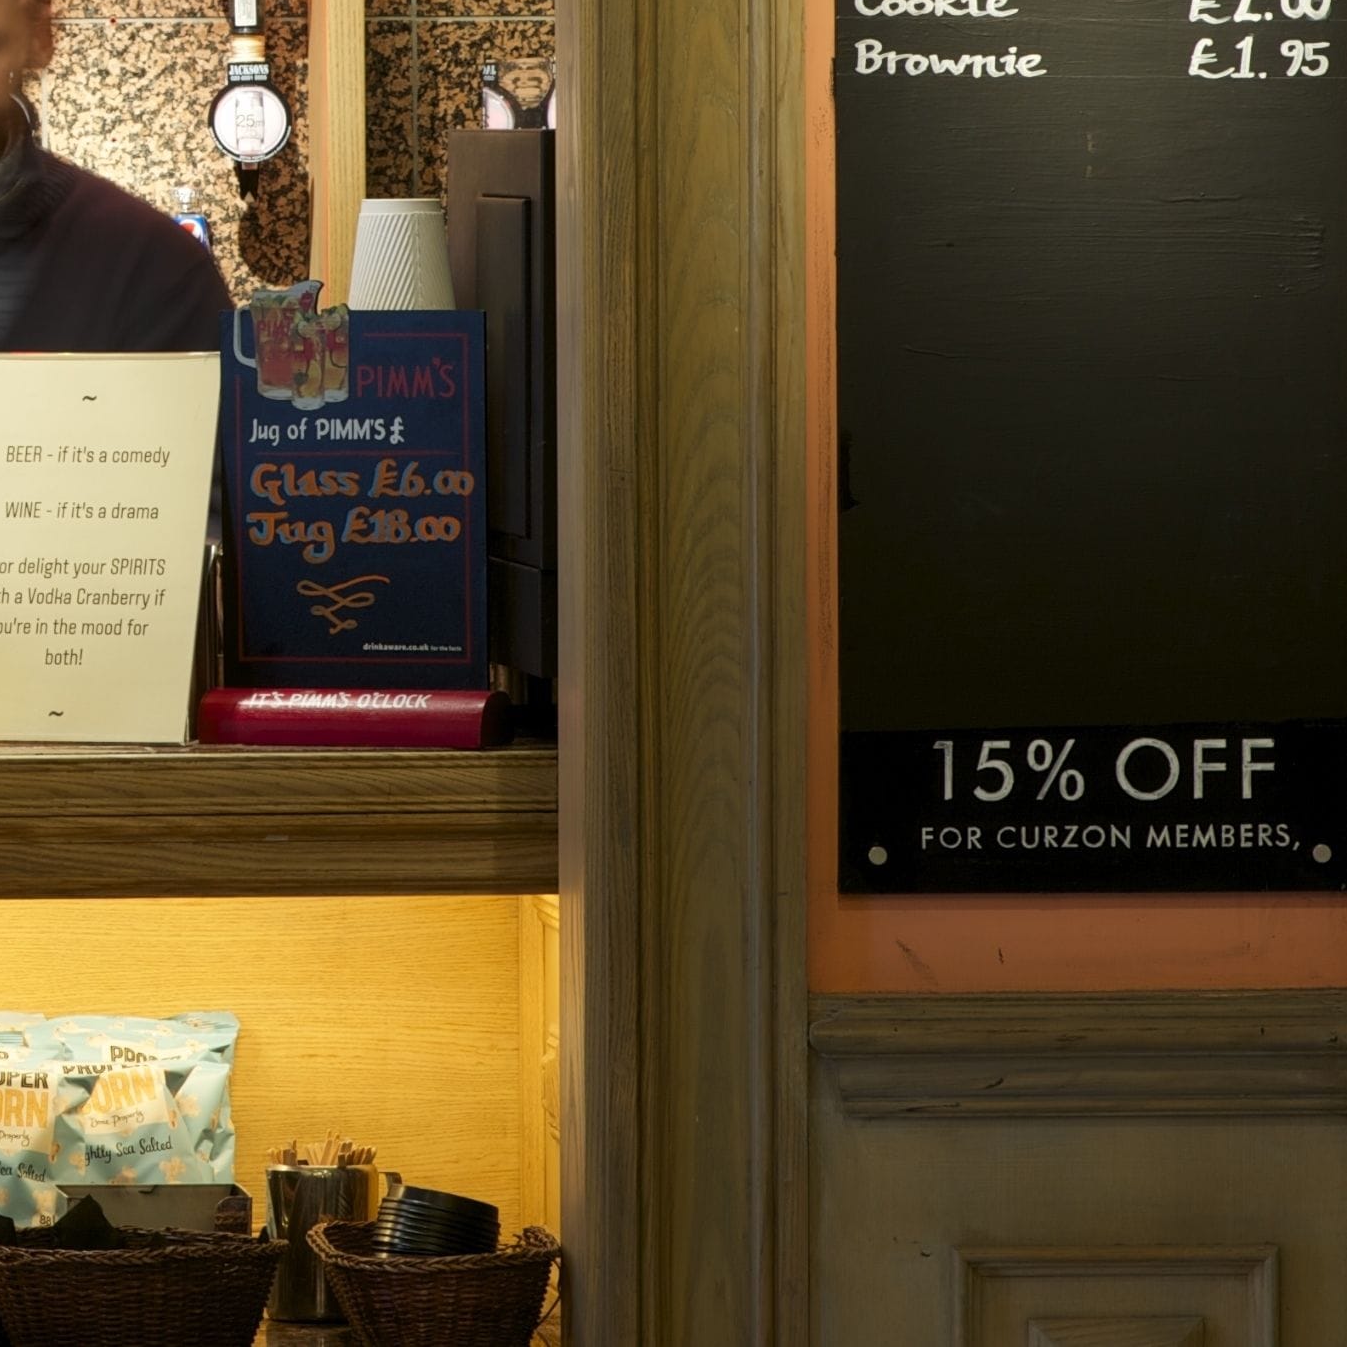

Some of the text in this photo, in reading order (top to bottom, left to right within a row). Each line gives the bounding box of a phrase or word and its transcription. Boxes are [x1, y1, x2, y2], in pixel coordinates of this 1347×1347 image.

[855, 36, 1330, 79] Brownie £1.95
[357, 358, 456, 398] PIMM'S
[249, 419, 386, 445] Jug of PIMM'S
[6, 445, 170, 467] BEER if it's a comedy
[250, 459, 474, 506] Glass £6.00
[246, 507, 462, 564] Jug £18.00
[18, 557, 69, 578] delight
[73, 560, 106, 578] your
[110, 557, 165, 575] SPIRITS
[14, 591, 23, 604] a
[28, 587, 71, 604] Vodka
[77, 587, 150, 608] Cranberry
[155, 587, 165, 605] if
[45, 647, 83, 666] both!
[363, 643, 429, 651] drinkaware.co.uk
[250, 692, 432, 707] IT'S PIMM'S O'CLOCK
[933, 738, 1275, 802] 15% OFF
[922, 827, 982, 850] FOR
[997, 825, 1131, 849] CURZON
